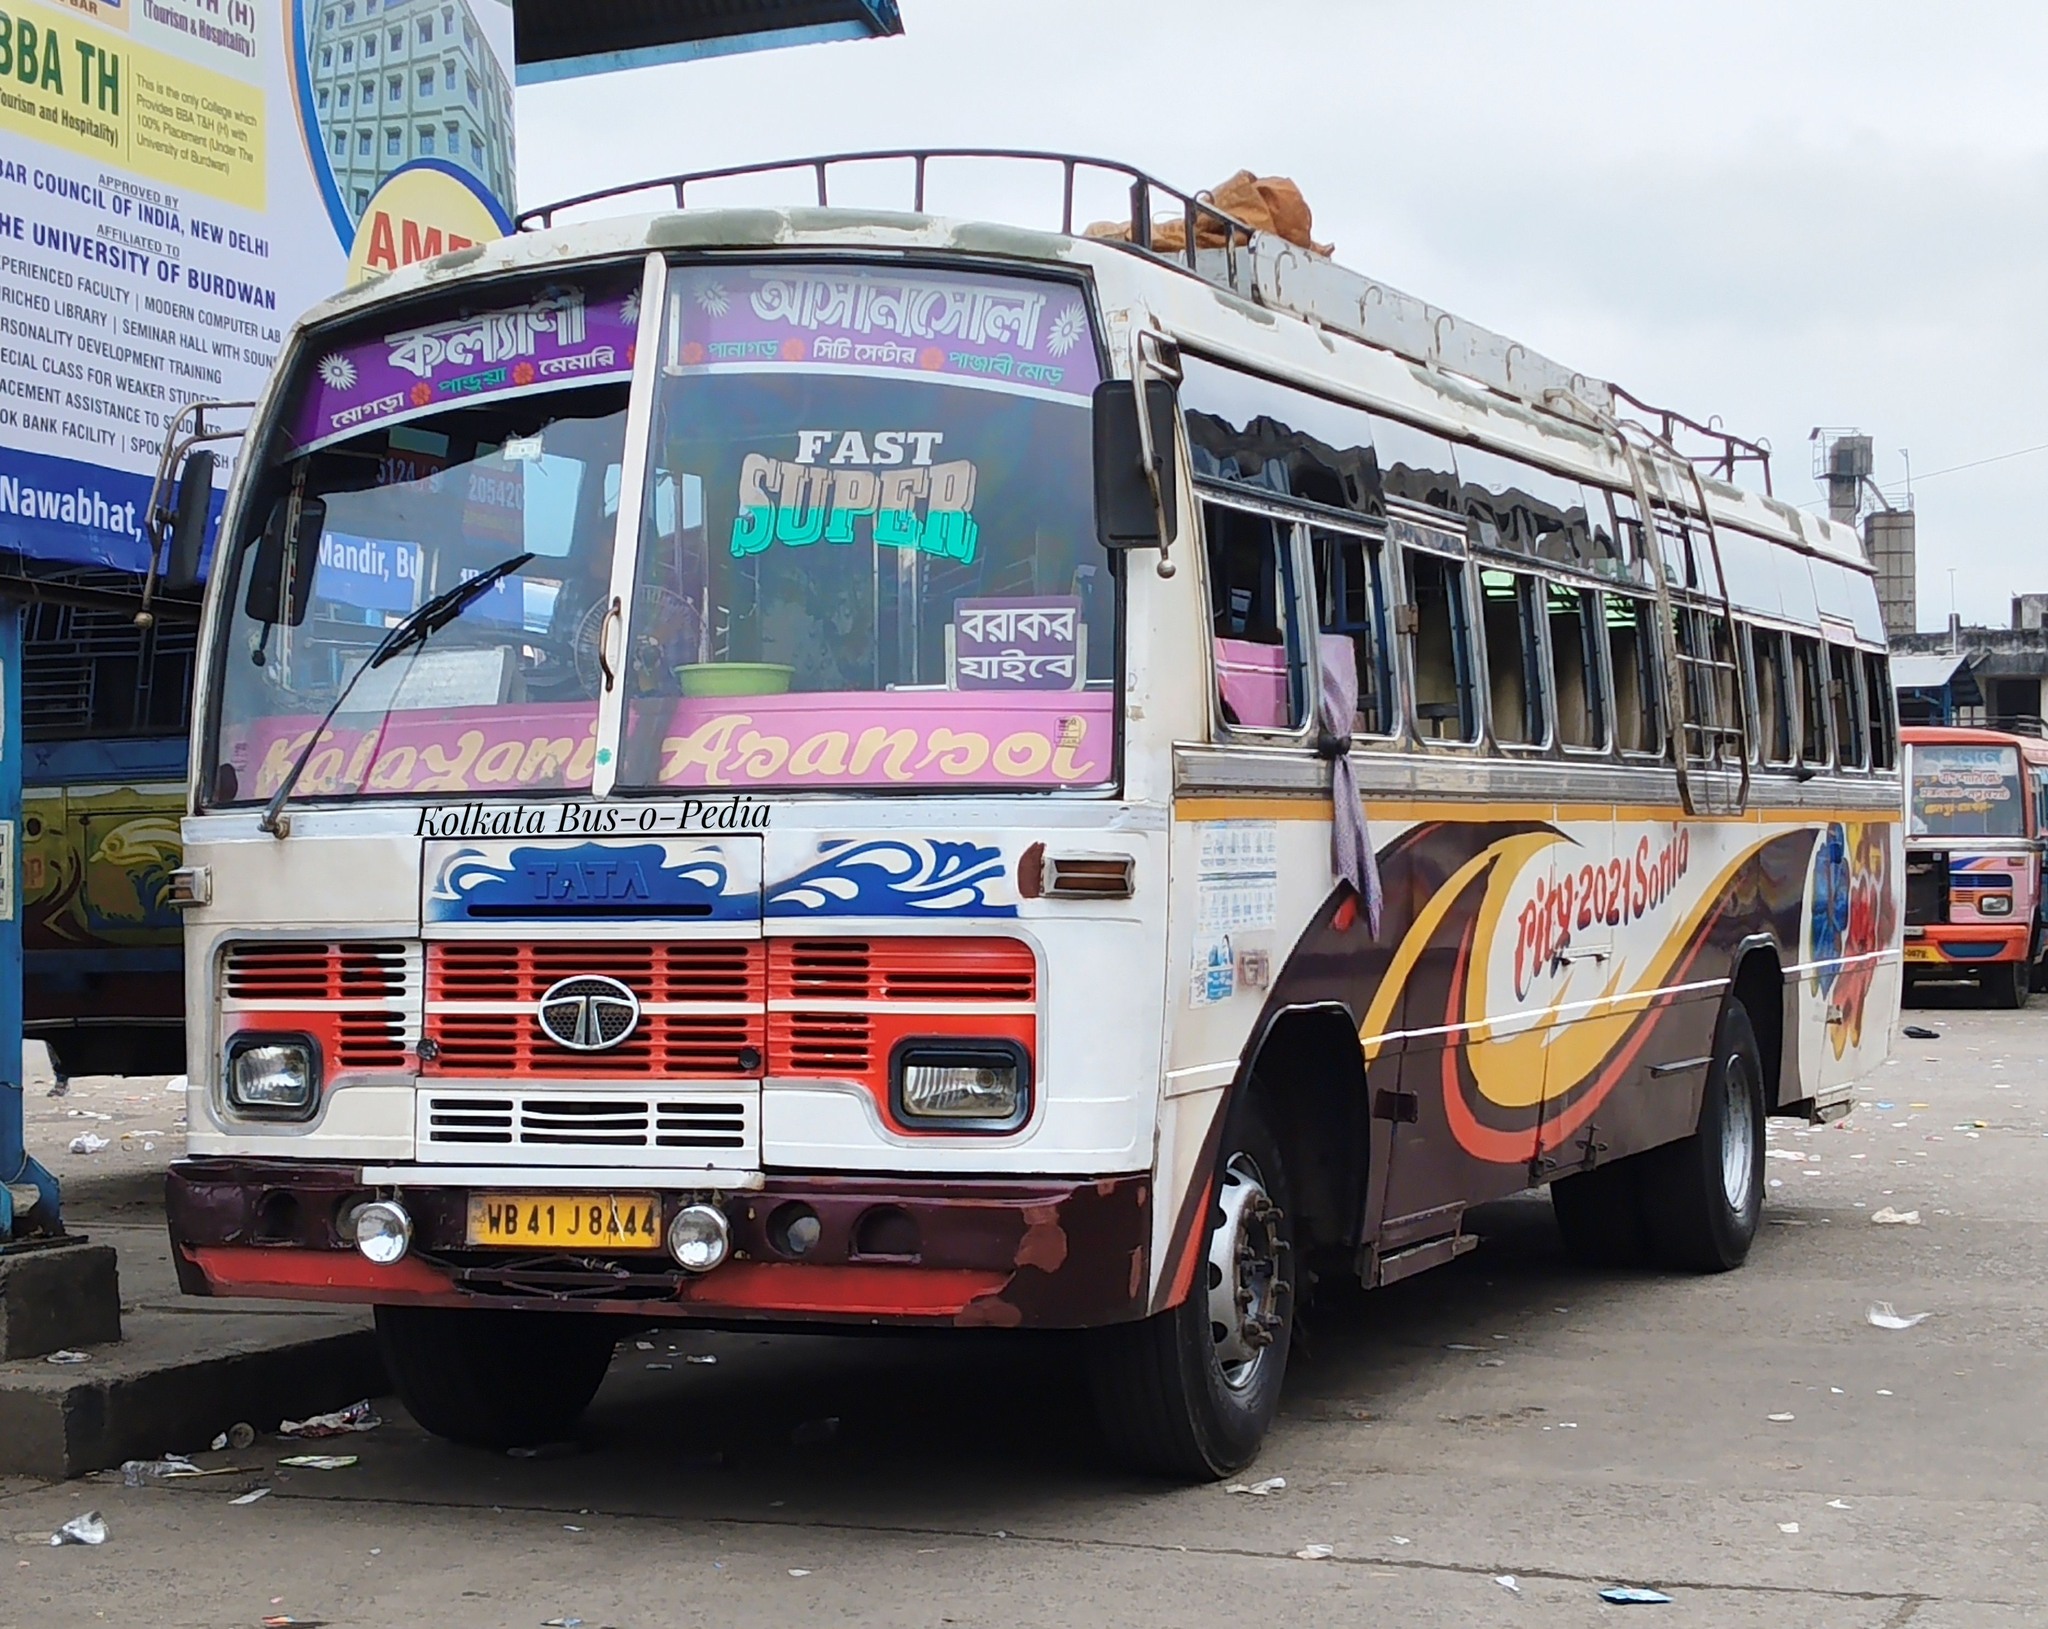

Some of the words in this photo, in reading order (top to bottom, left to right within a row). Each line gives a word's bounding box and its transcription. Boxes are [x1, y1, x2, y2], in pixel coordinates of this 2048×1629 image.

[75, 38, 119, 117] TH
[136, 72, 154, 92] This
[156, 81, 163, 95] is
[165, 86, 179, 100] the
[181, 92, 199, 110] only
[200, 97, 232, 120] College
[234, 111, 257, 126] which
[0, 86, 36, 117] ourism
[39, 105, 58, 124] and
[61, 113, 119, 149] Hospitality)
[136, 93, 174, 117] Provides
[231, 128, 248, 143] with
[137, 114, 161, 133] 100%
[162, 121, 207, 148] Placement
[209, 137, 237, 157] (Under
[238, 146, 254, 163] The
[136, 132, 179, 160] University
[180, 148, 189, 161] of
[190, 149, 230, 177] Burdwan)
[33, 168, 106, 210] COUNCIL
[112, 194, 132, 217] OF
[138, 202, 186, 237] INDIA,
[191, 218, 223, 244] NEW
[228, 230, 269, 259] DELHI
[99, 173, 161, 204] APPROVED
[165, 194, 180, 209] BY
[33, 221, 150, 277] UNIVERSITY
[156, 258, 181, 284] OF
[188, 267, 276, 311] BURDWAN
[97, 223, 163, 253] AFFILIATED
[165, 243, 181, 259] TO
[0, 255, 74, 288] PERIENCED
[77, 276, 130, 305] FACULTY
[144, 296, 195, 323] MODERN
[198, 308, 258, 339] COMPUTER
[261, 326, 281, 343] LAB
[0, 286, 50, 312] RICHED
[54, 299, 108, 328] LIBRARY
[122, 318, 176, 347] SEMINAR
[179, 332, 208, 354] HALL
[211, 340, 241, 362] WITH
[749, 270, 1046, 351] আসানসোল
[383, 285, 587, 379] কল্যাণী
[1, 347, 38, 370] ECIAL
[42, 356, 84, 380] CLASS
[87, 367, 112, 388] FOR
[115, 374, 165, 400] WEAKER
[77, 336, 165, 372] DEVELOPMENT
[169, 358, 222, 384] TRAINING
[538, 345, 616, 376] মেমারি
[707, 340, 779, 361] পানাগড়
[813, 335, 852, 360] সিটি
[854, 341, 918, 365] সেন্টার
[1016, 361, 1066, 387] মোড়
[22, 413, 57, 434] BANK
[62, 421, 116, 446] FACILITY
[65, 391, 141, 425] ASSISTANCE
[145, 410, 161, 428] TO
[794, 430, 944, 466] FAST
[0, 474, 142, 543] Nawabhat,
[730, 452, 979, 565] SUPER
[959, 607, 1077, 644] বরাকর
[957, 648, 1076, 683] যাইবে
[254, 718, 598, 799] Kalayani
[657, 713, 1096, 785] Asansol
[526, 860, 650, 900] TATA
[487, 1203, 518, 1235] WB
